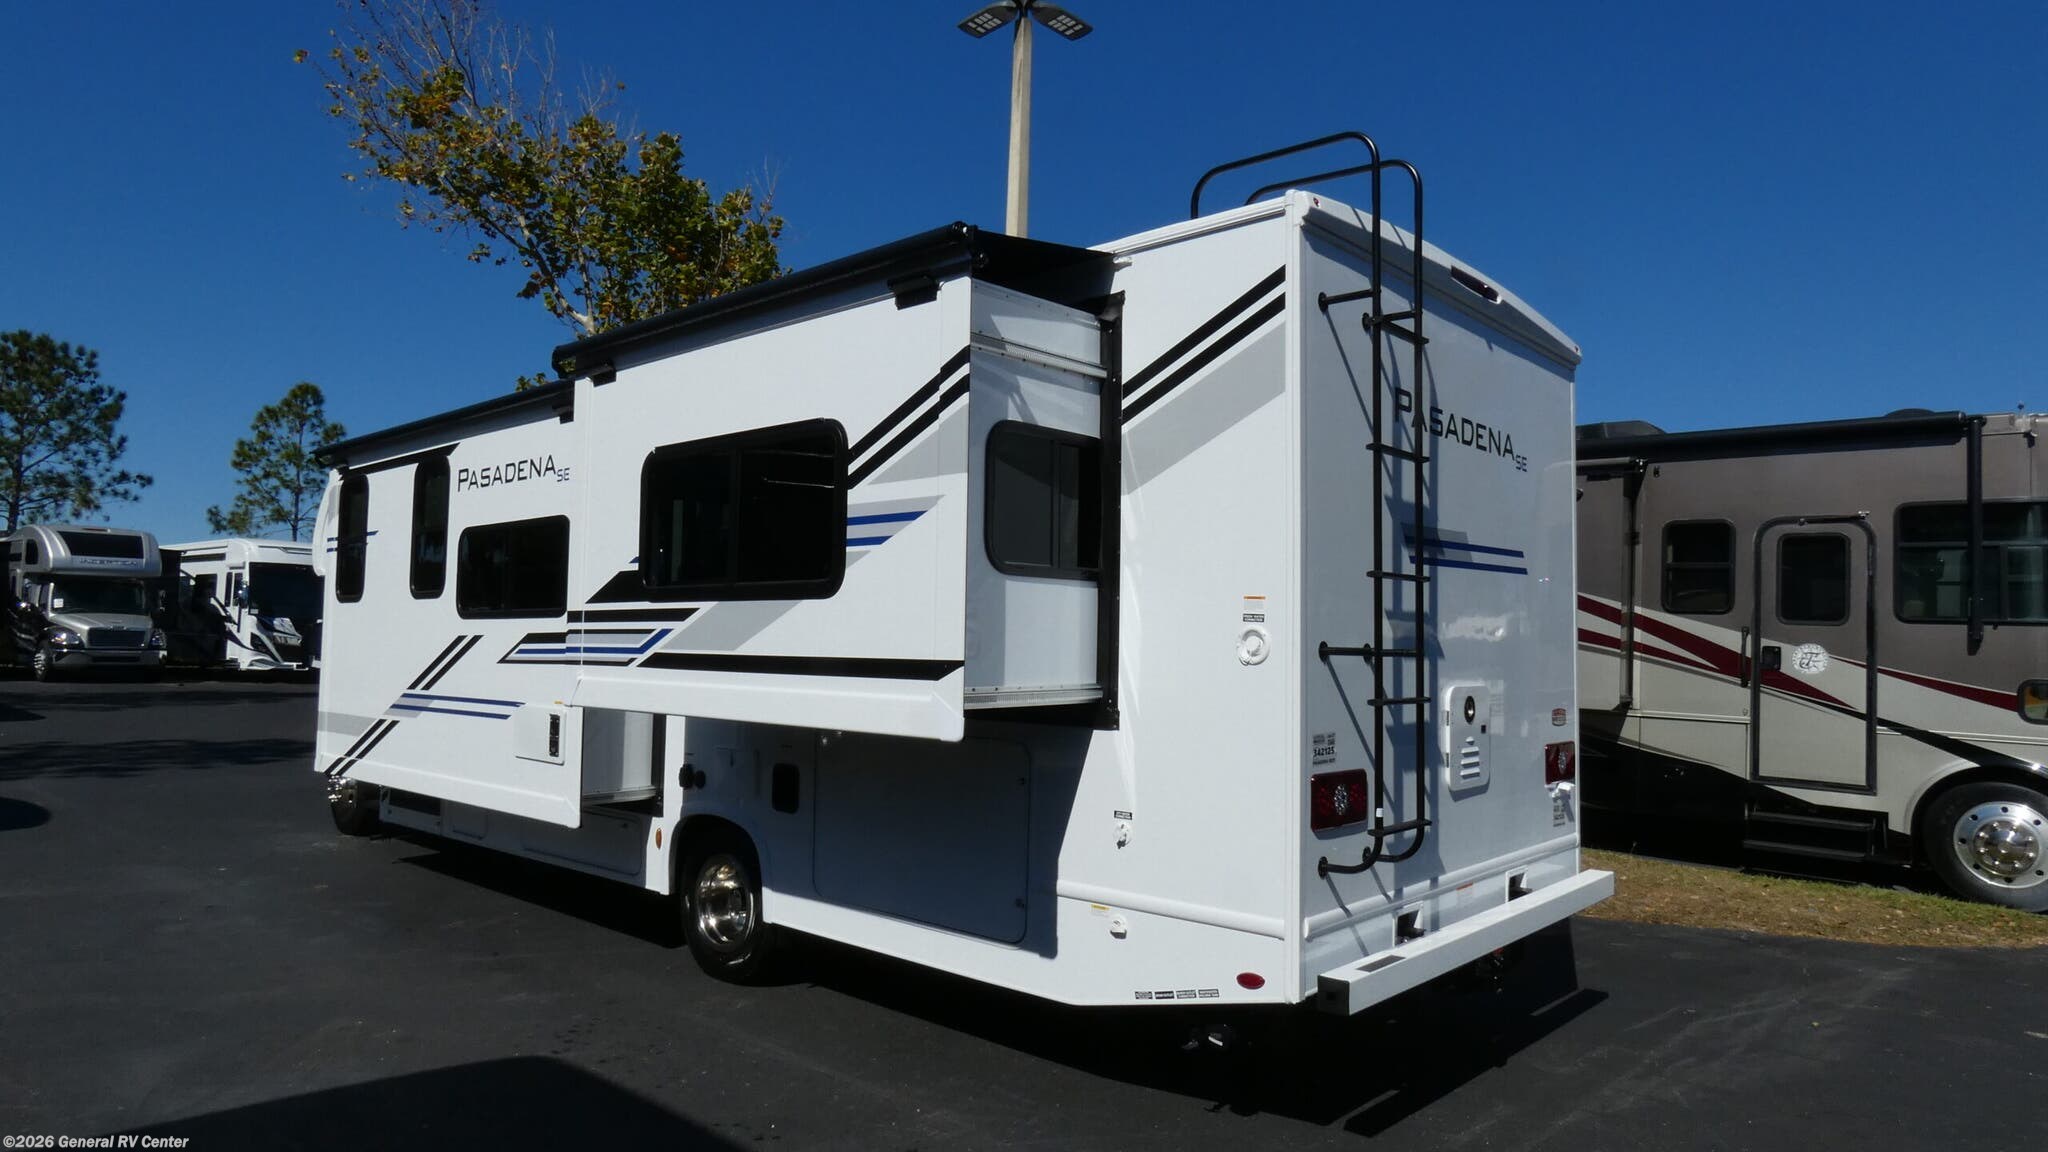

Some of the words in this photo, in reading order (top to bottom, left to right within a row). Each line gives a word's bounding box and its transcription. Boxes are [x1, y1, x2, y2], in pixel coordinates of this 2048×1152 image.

[1395, 387, 1515, 461] PASADENA
[458, 454, 556, 492] PASADENA
[556, 467, 570, 482] SE
